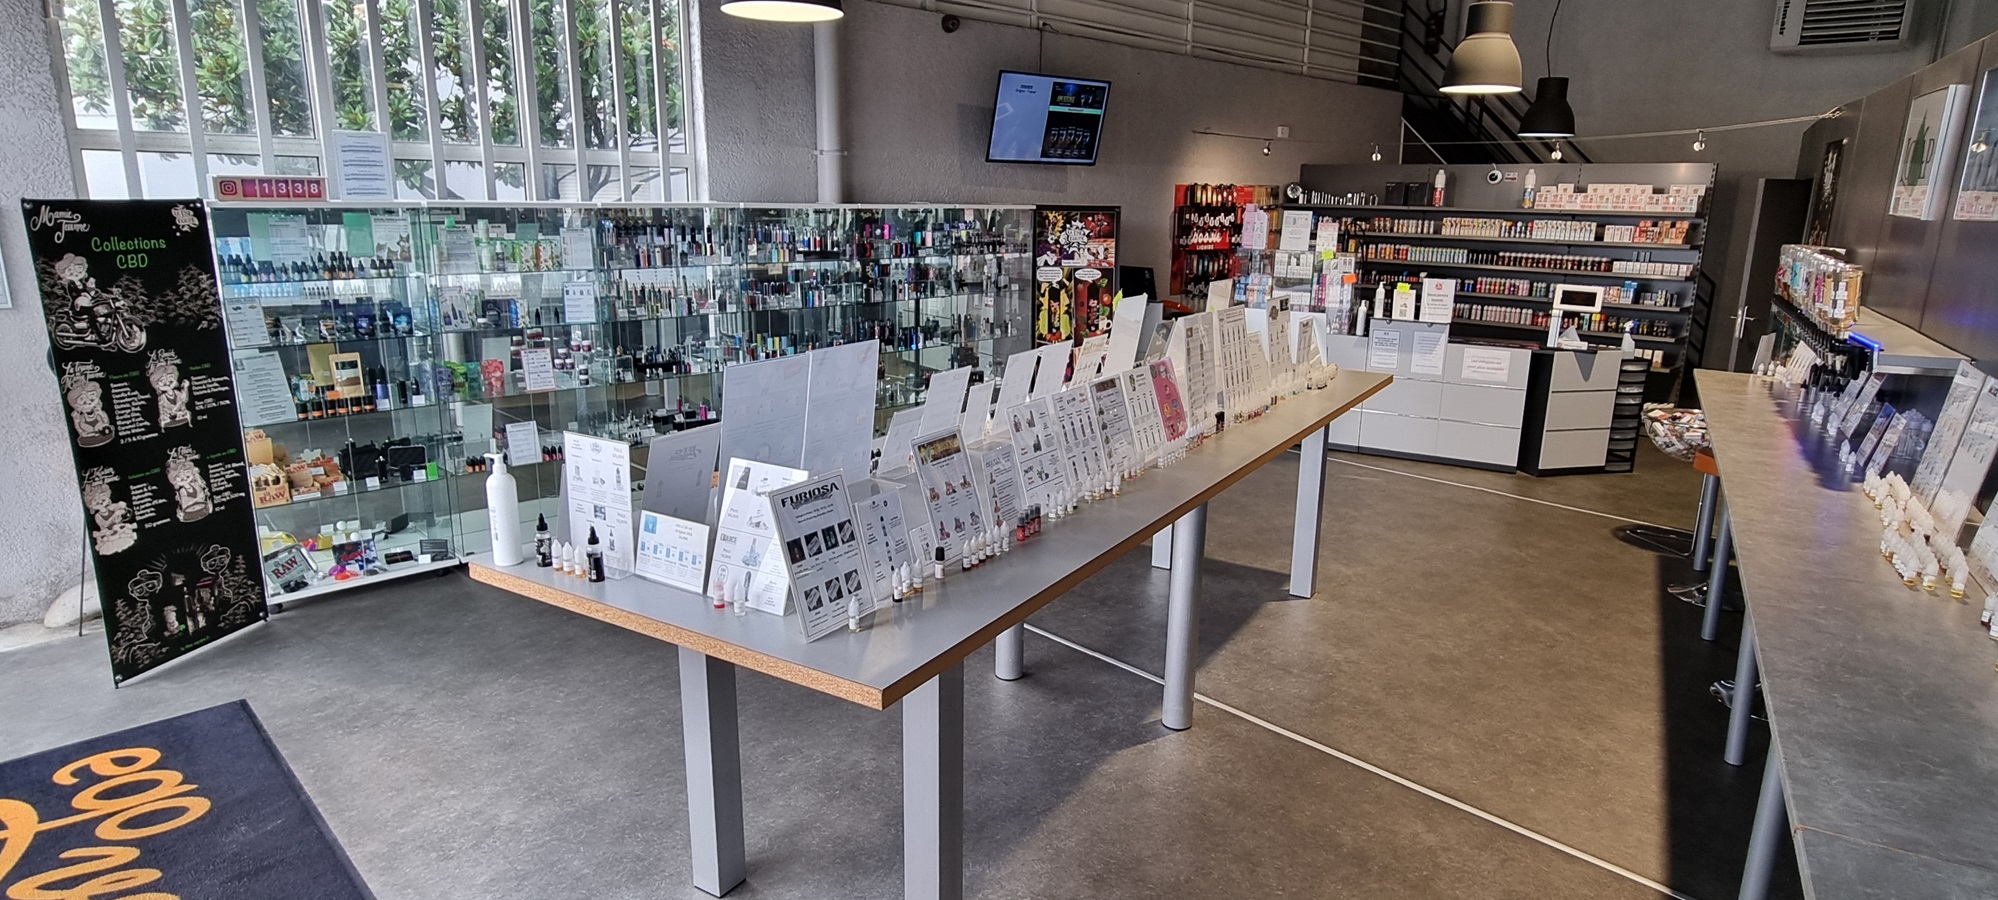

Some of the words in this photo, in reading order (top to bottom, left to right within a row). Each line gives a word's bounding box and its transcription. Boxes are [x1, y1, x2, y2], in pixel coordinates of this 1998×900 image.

[30, 205, 81, 231] Mamie
[54, 219, 91, 243] Jeanne
[91, 236, 167, 252] Collections
[116, 253, 148, 269] CBD
[259, 490, 286, 504] RAW
[780, 482, 840, 508] FURIOSA
[271, 555, 299, 579] RAW
